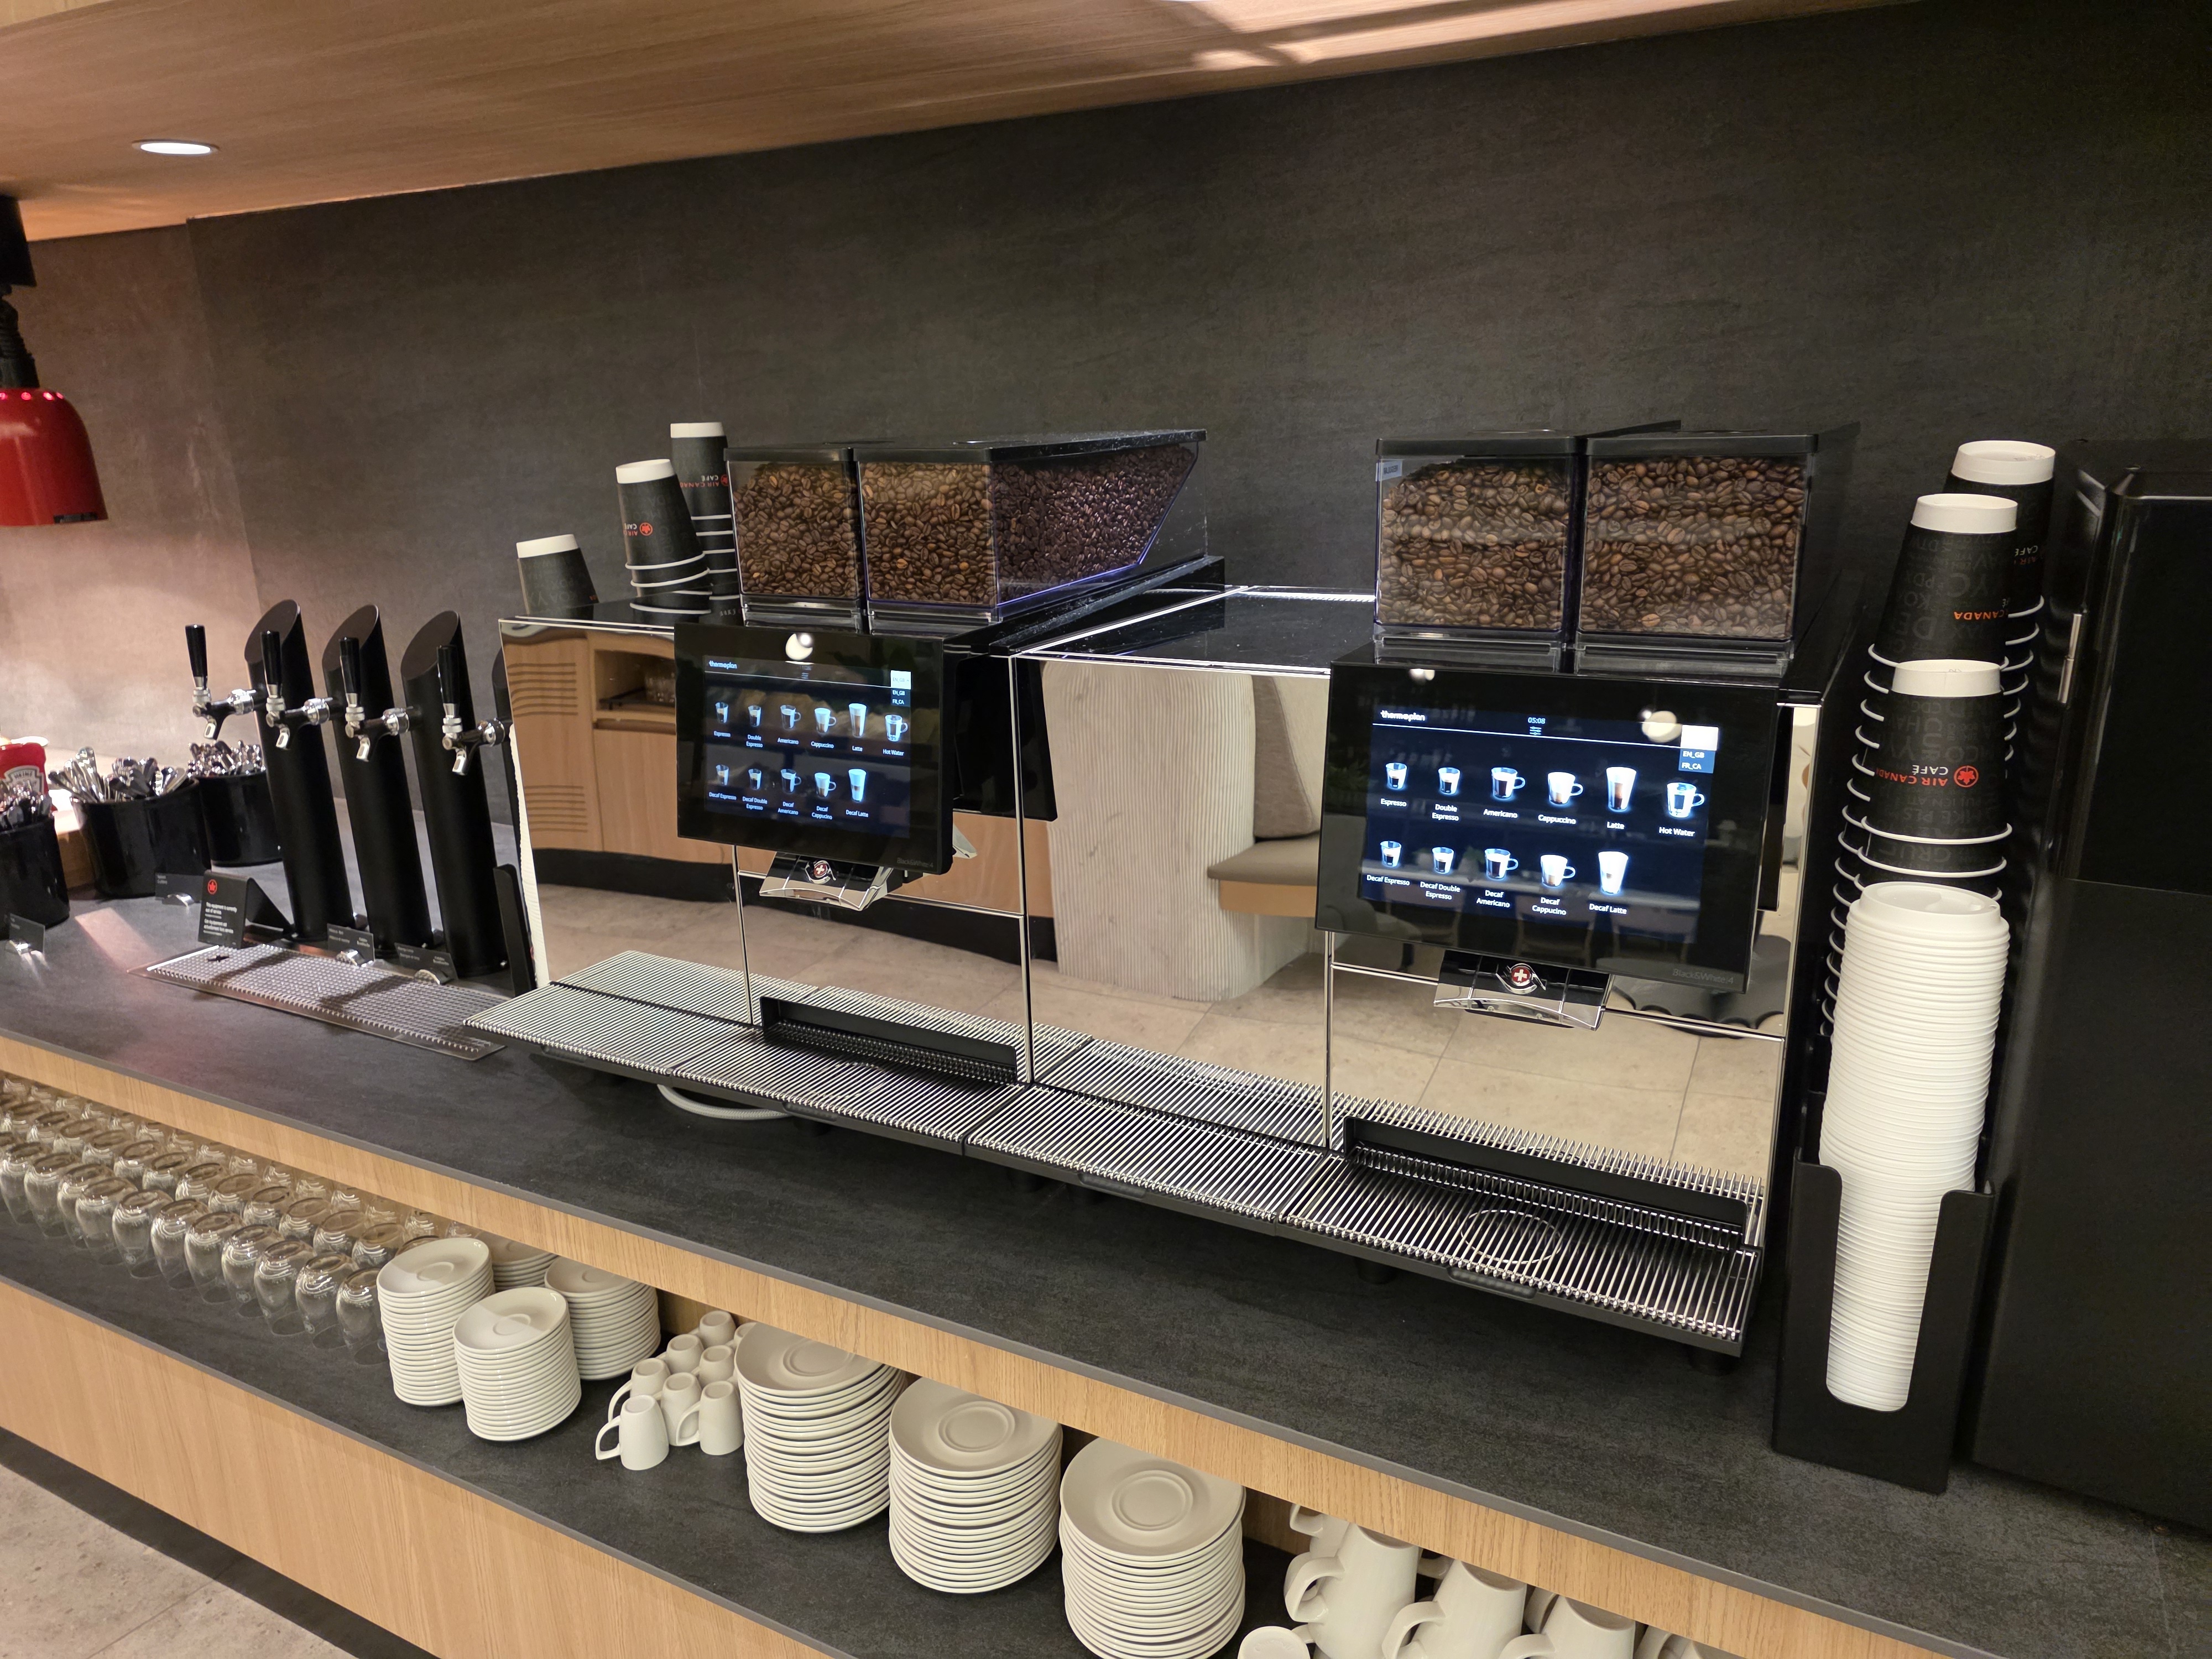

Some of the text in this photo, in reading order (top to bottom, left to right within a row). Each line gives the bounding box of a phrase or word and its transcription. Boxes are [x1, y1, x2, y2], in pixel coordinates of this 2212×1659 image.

[1380, 710, 1426, 722] thermoplan
[1682, 751, 1705, 759] EN_GB
[1912, 764, 1949, 775] CAFÉ
[1922, 777, 1948, 786] AIR
[1380, 799, 1407, 807] Espresso
[1434, 804, 1458, 812] Double
[1432, 812, 1459, 821] Espresso
[1483, 808, 1518, 818] Americano
[1538, 814, 1577, 825] Cappuccino
[1606, 821, 1625, 830] Latte
[1658, 827, 1695, 837] Hot Water
[1366, 874, 1410, 886] Decaf Espresso
[1420, 881, 1460, 893] Decaf Double
[1426, 891, 1452, 900] Espresso
[1485, 890, 1504, 898] Decaf
[1476, 898, 1510, 908] Americano
[1541, 897, 1560, 905] Decaf
[1532, 905, 1567, 916] Cappucino
[1589, 903, 1627, 915] Decaf Latte
